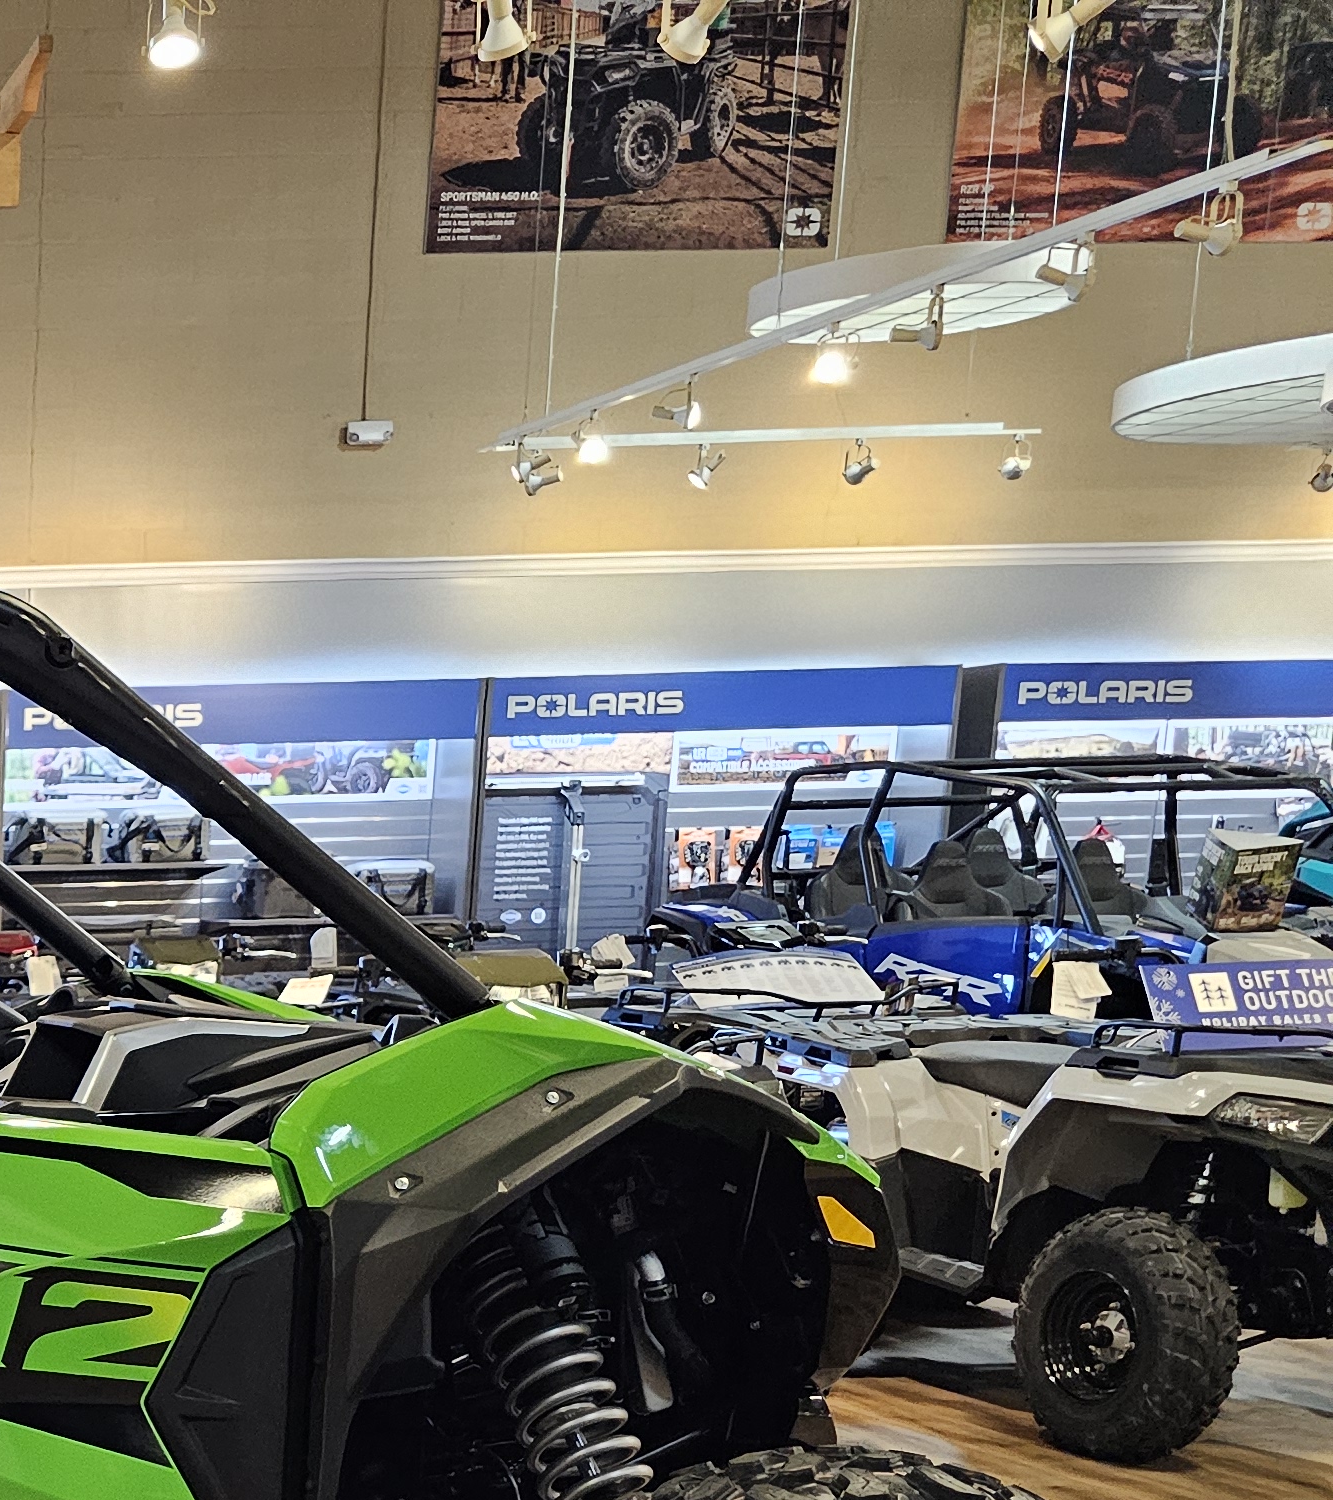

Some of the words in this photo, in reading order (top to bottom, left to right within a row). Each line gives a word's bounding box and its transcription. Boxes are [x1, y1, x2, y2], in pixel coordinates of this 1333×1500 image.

[1017, 679, 1193, 705] POLARIS
[507, 690, 684, 719] POLARIS
[1237, 970, 1290, 990] GIFT
[1201, 1015, 1267, 1027] HOLIDAY
[1272, 1013, 1322, 1025] SALES
